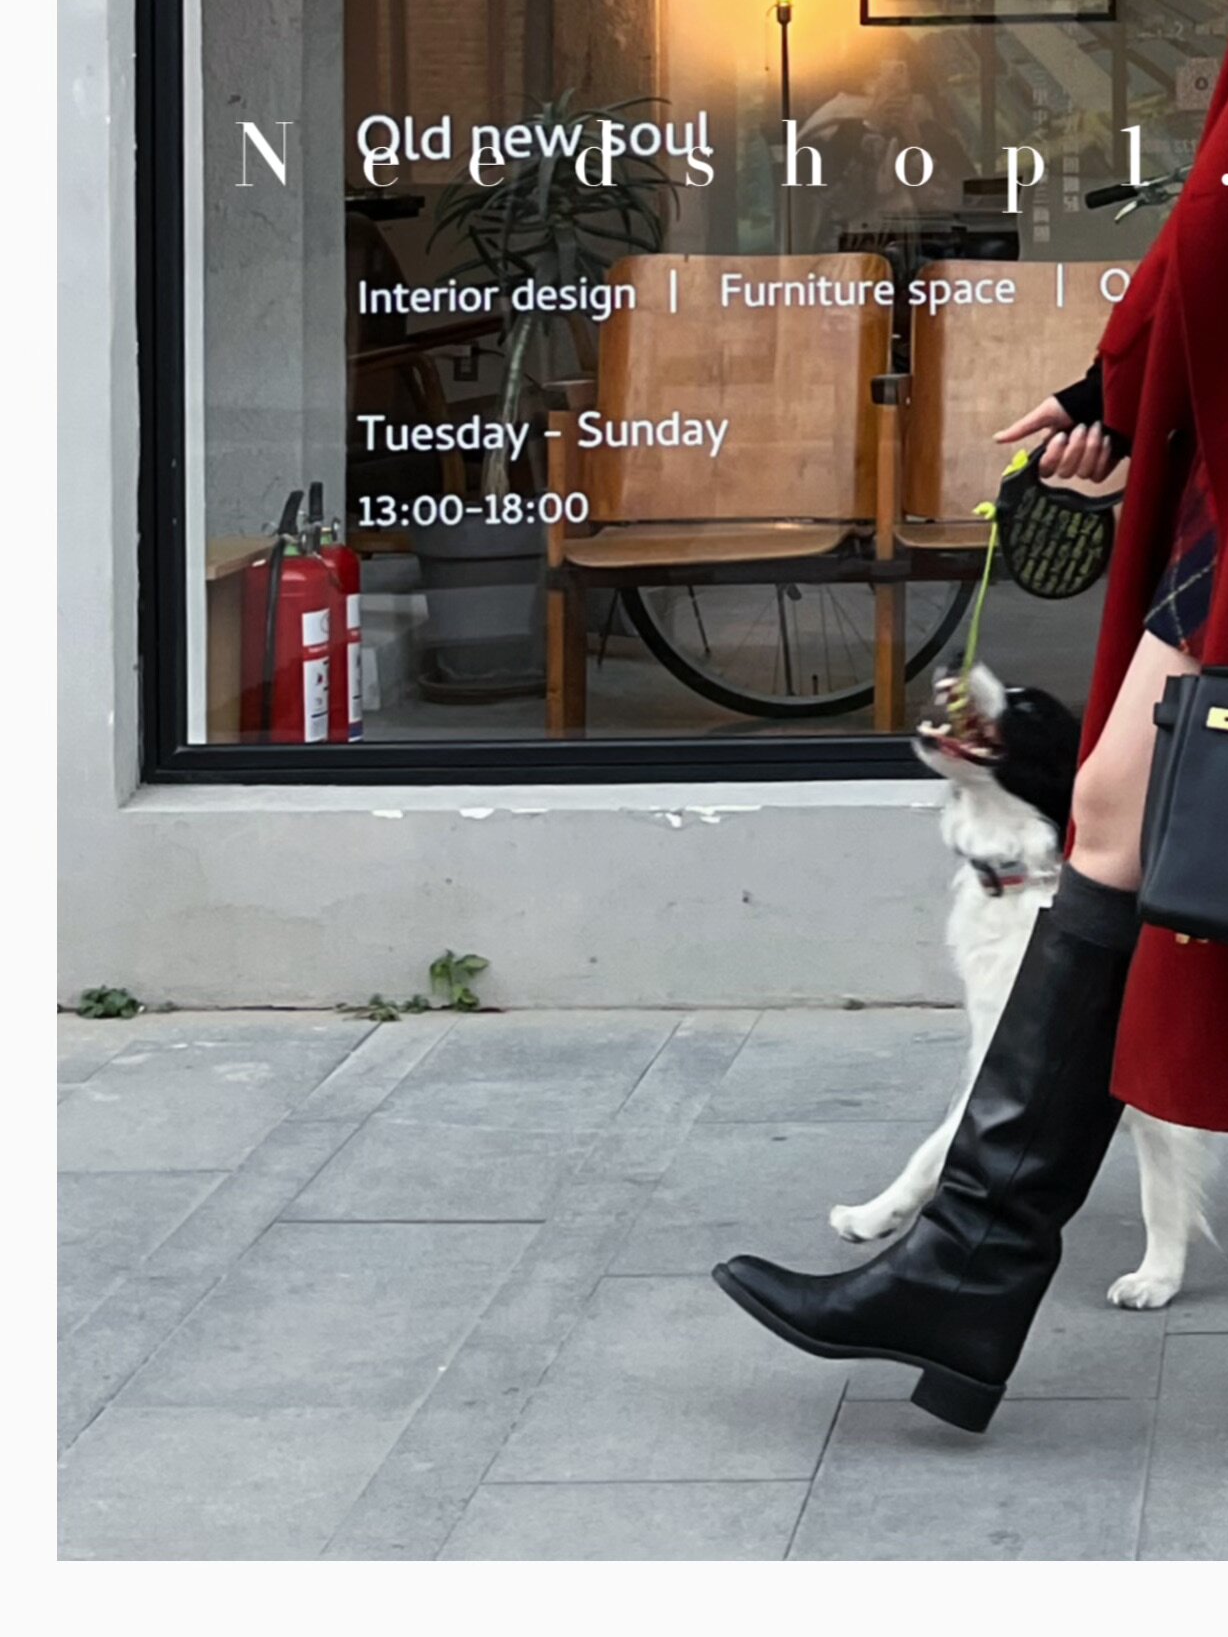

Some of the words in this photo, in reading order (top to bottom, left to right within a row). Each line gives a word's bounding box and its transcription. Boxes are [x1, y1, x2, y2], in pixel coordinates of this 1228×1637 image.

[471, 123, 581, 161] new
[609, 110, 715, 157] soul
[358, 278, 499, 315] Interior
[511, 276, 637, 321] design
[720, 272, 895, 308] Furniture
[908, 276, 1016, 316] space
[356, 414, 530, 461] Tuesday
[577, 411, 730, 457] Sunday
[358, 491, 590, 527] 13:00-18:00
